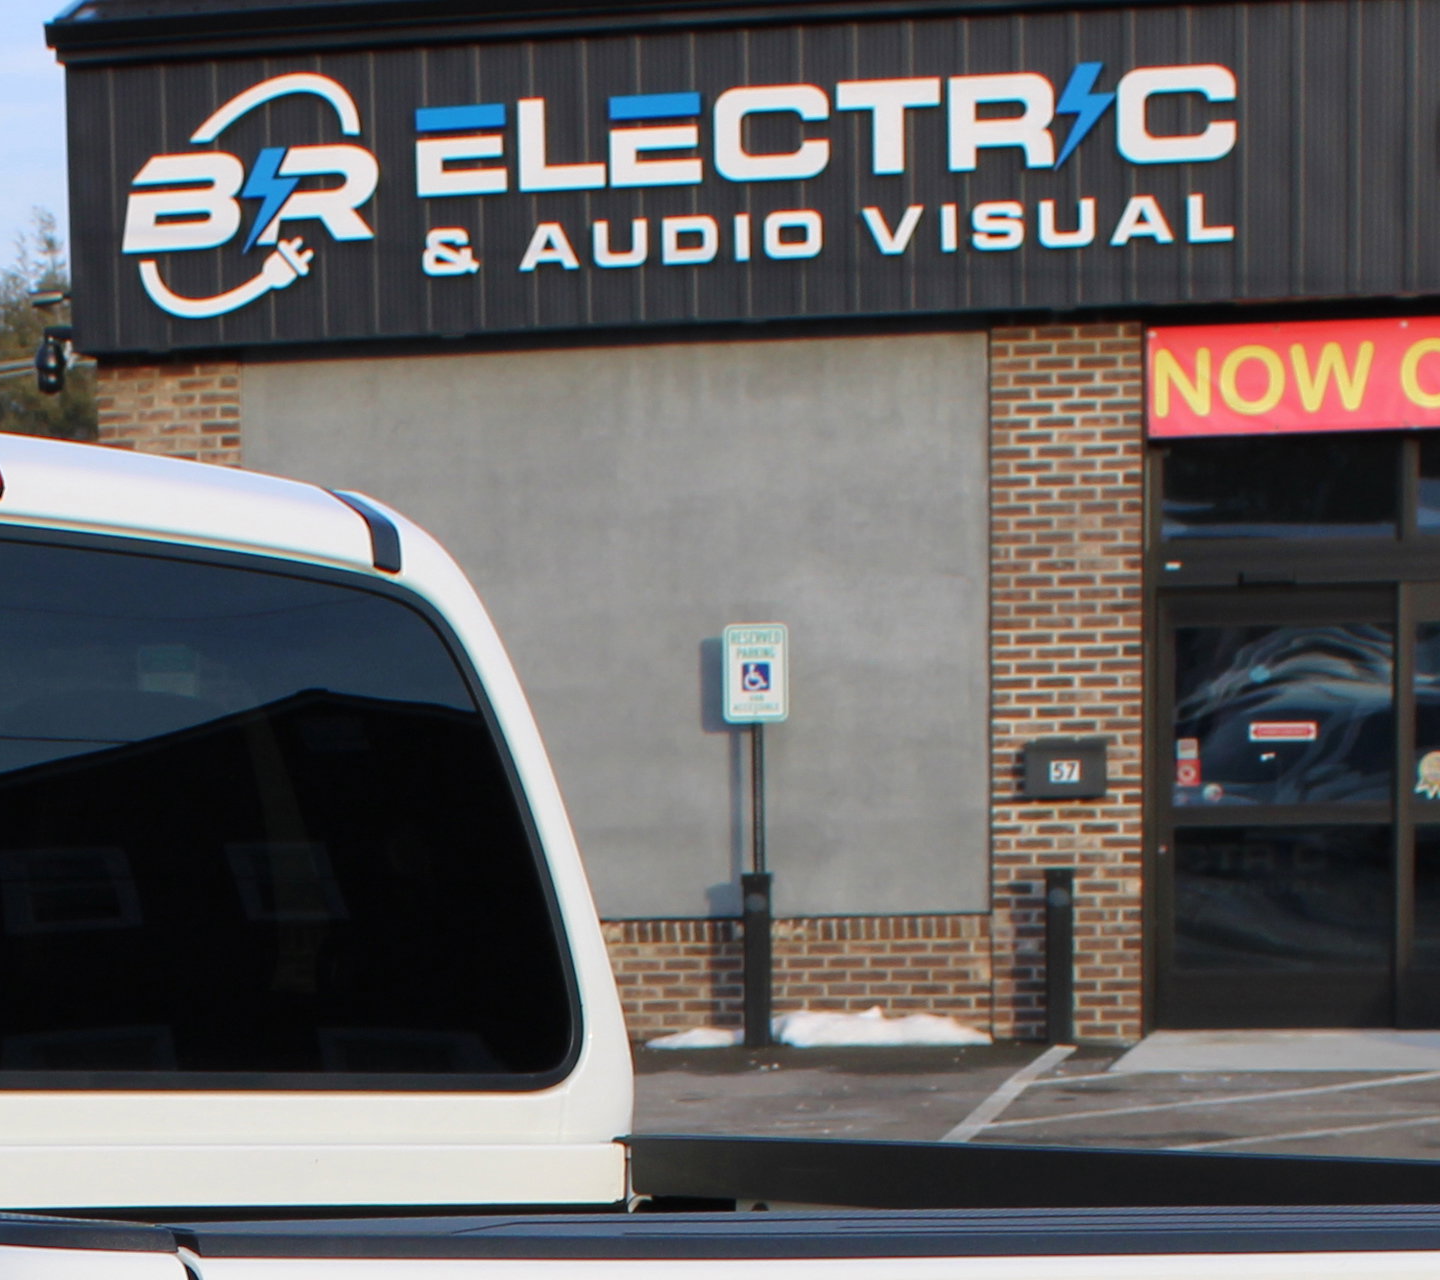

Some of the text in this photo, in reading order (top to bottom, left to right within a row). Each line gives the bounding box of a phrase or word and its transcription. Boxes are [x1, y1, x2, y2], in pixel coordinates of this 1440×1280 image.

[421, 194, 1237, 277] & AUDIO VISUAL
[1153, 341, 1375, 419] NOW
[1052, 761, 1077, 780] 57
